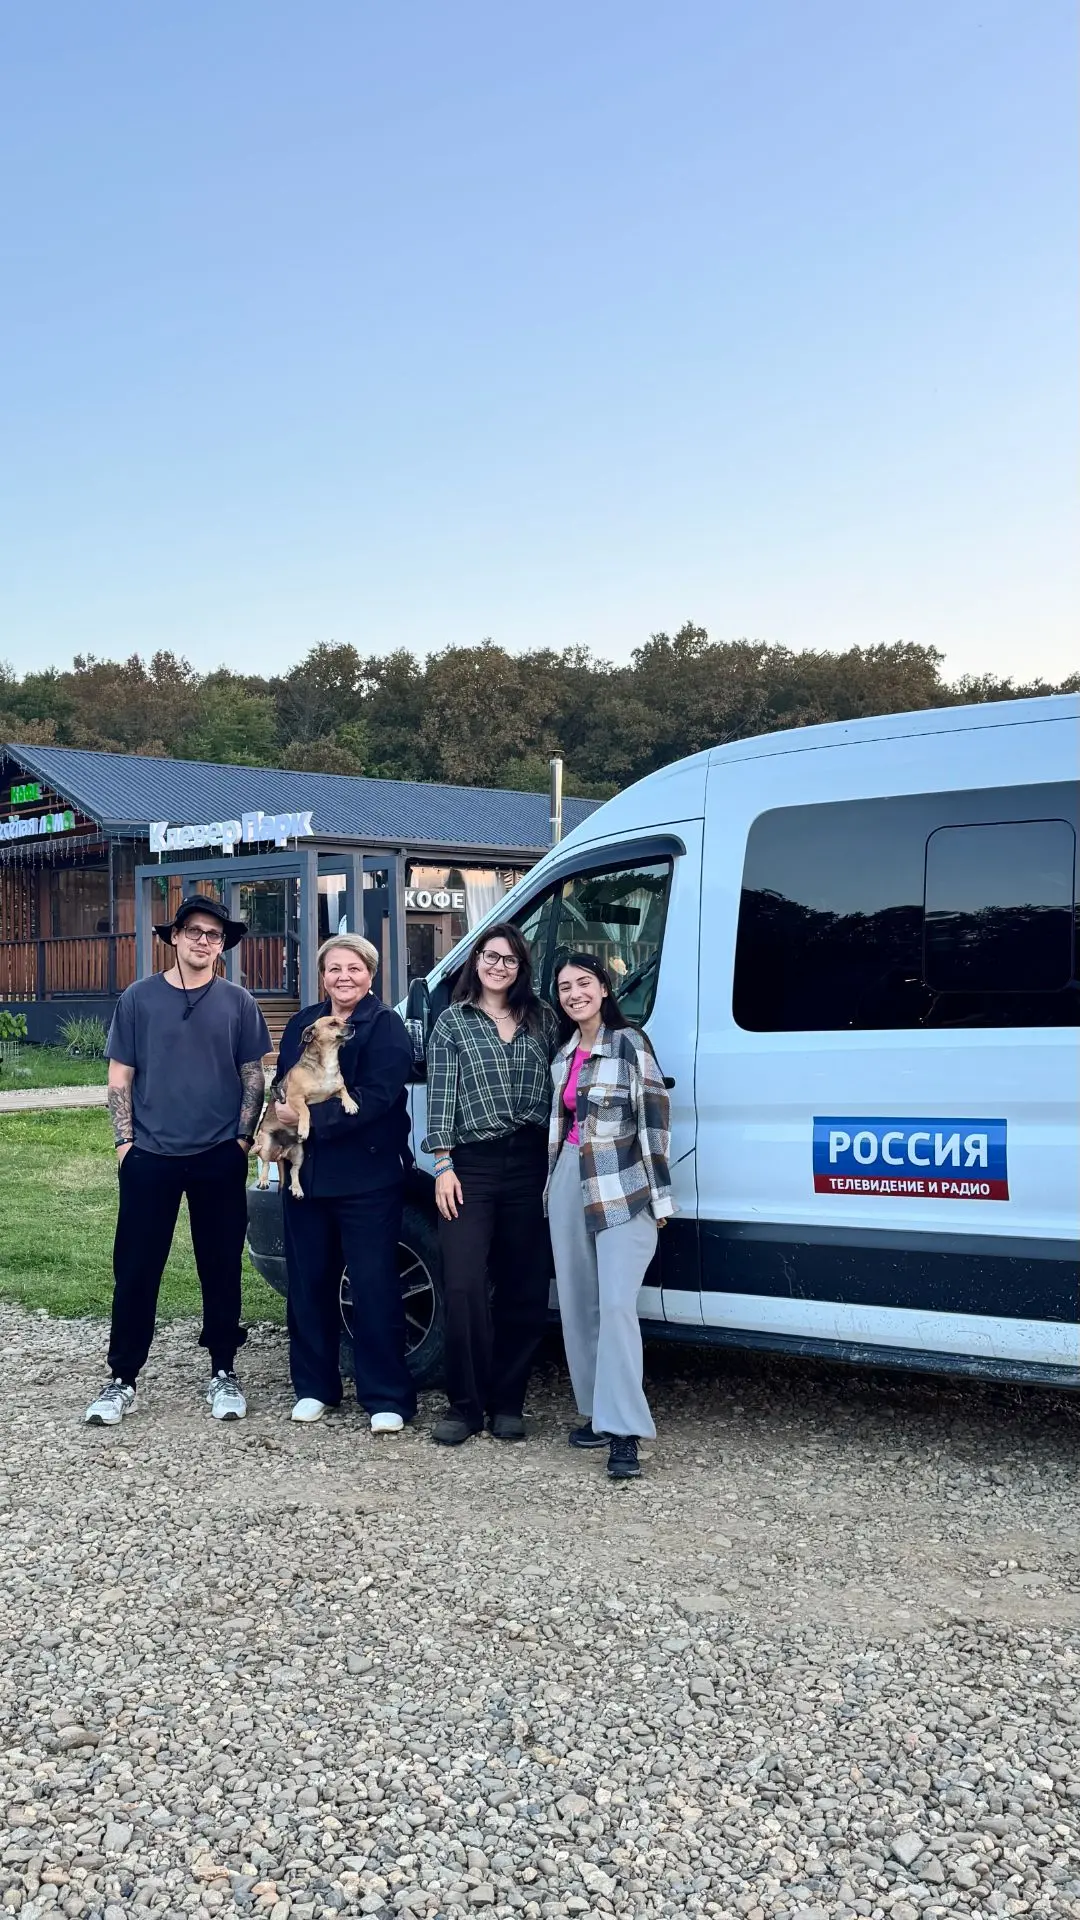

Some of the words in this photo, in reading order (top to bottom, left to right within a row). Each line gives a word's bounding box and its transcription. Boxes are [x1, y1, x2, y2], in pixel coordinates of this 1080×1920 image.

[11, 783, 43, 804] КАФЕ
[150, 821, 242, 853] Клевер
[242, 811, 314, 847] Парк
[405, 890, 465, 909] КОФЕ
[829, 1131, 988, 1168] РОССИЯ
[829, 1178, 925, 1194] ТЕЛЕВИДЕНИЕ
[928, 1183, 938, 1194] И
[941, 1181, 990, 1196] РАДИО
